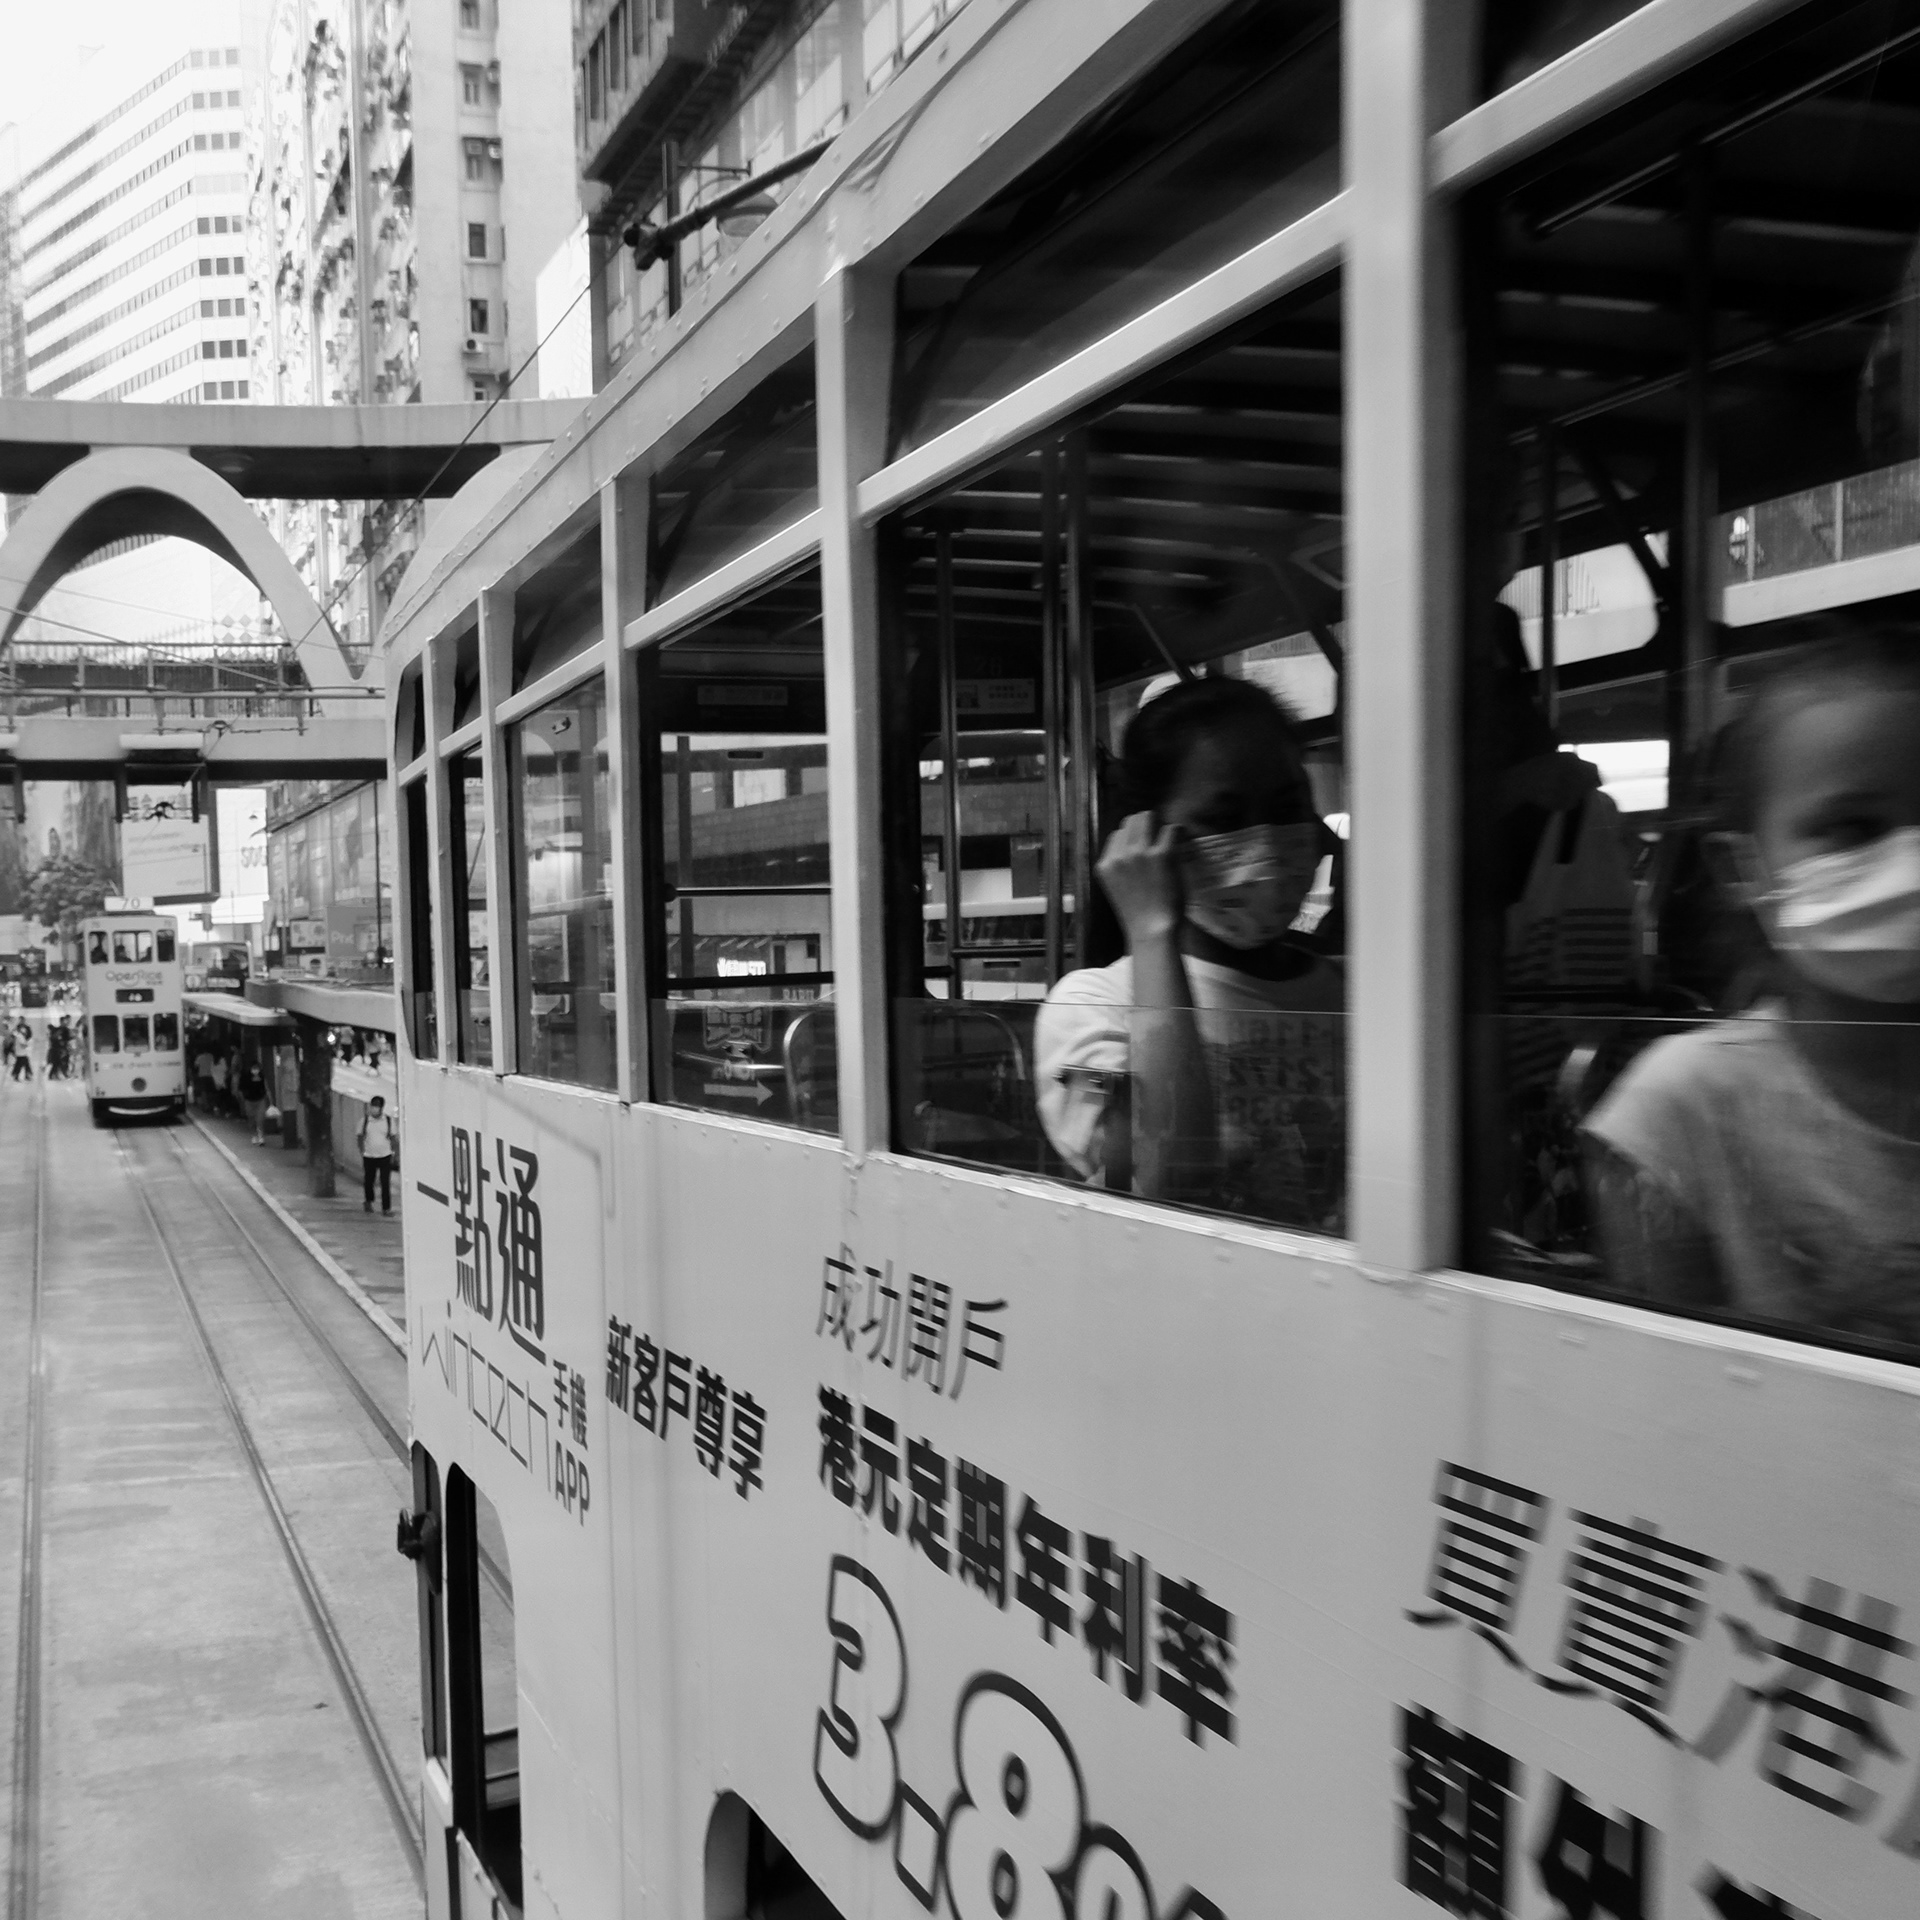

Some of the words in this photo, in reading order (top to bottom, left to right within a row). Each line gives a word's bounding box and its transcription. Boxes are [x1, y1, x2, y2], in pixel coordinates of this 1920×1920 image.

[417, 1125, 546, 1366] 一點通
[816, 1242, 1008, 1400] 成功開戶
[553, 1358, 588, 1451] 手機
[605, 1314, 768, 1502] 新客戶尊享
[816, 1382, 1239, 1752] 港元定期年利率
[1400, 1459, 1920, 1860] 買賣港
